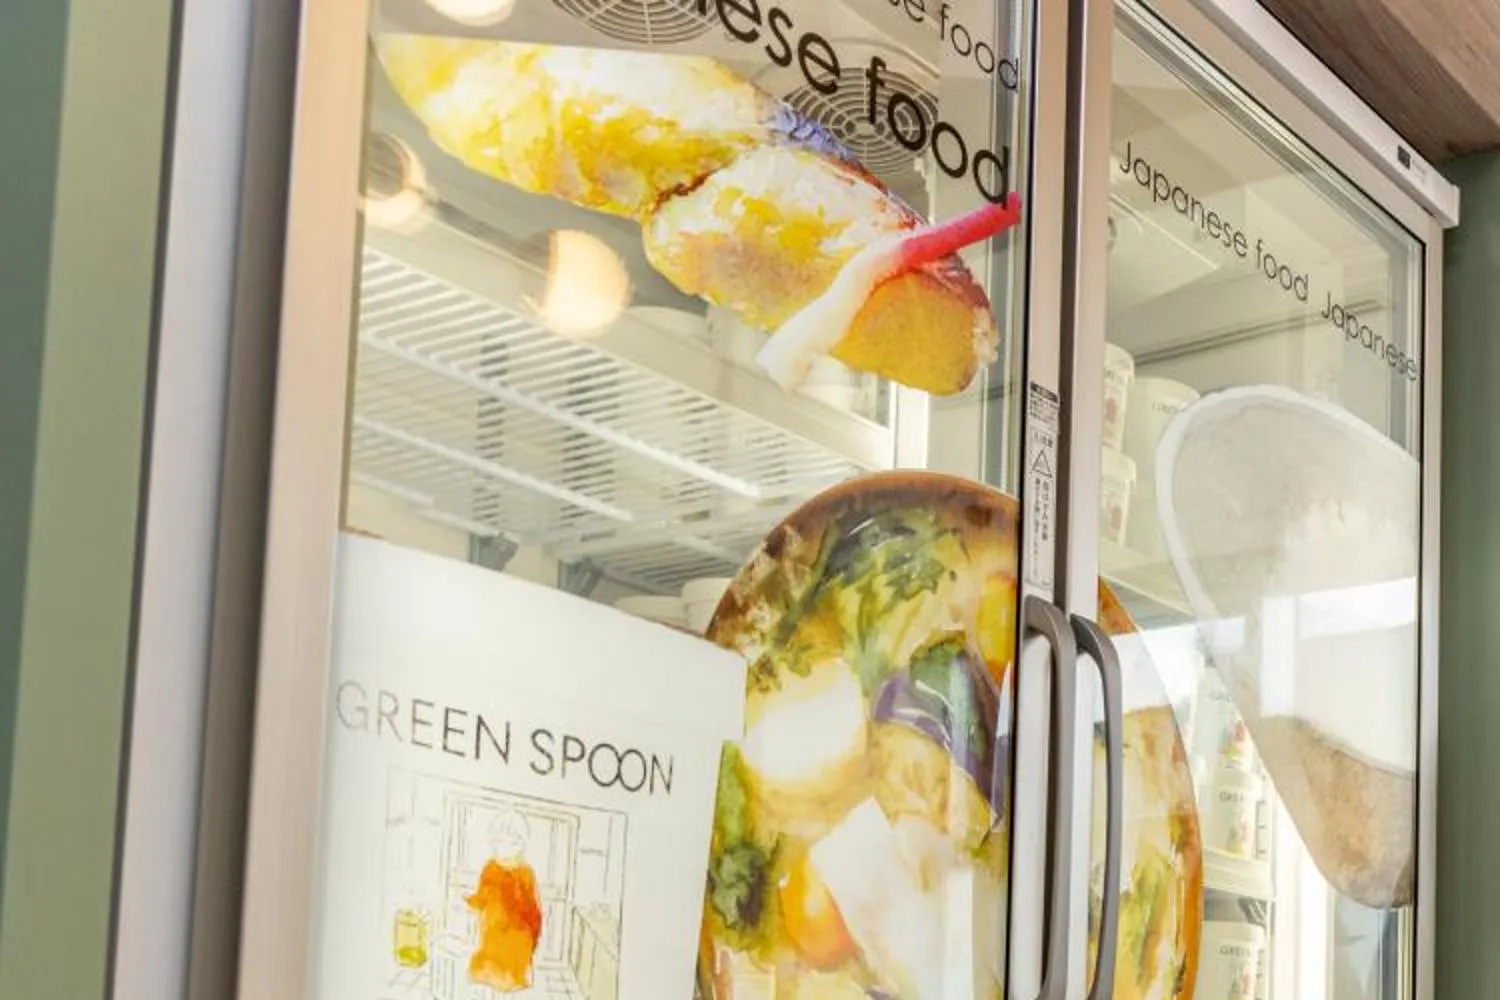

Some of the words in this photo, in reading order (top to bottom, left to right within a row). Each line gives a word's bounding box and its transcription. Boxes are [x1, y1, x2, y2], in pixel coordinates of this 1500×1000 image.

[941, 3, 1019, 92] food
[866, 56, 1010, 208] food
[1119, 141, 1249, 260] Japanese
[1255, 238, 1310, 302] food
[1321, 290, 1420, 382] Japanese
[336, 680, 510, 764] GREEN
[530, 728, 674, 797] SPOON
